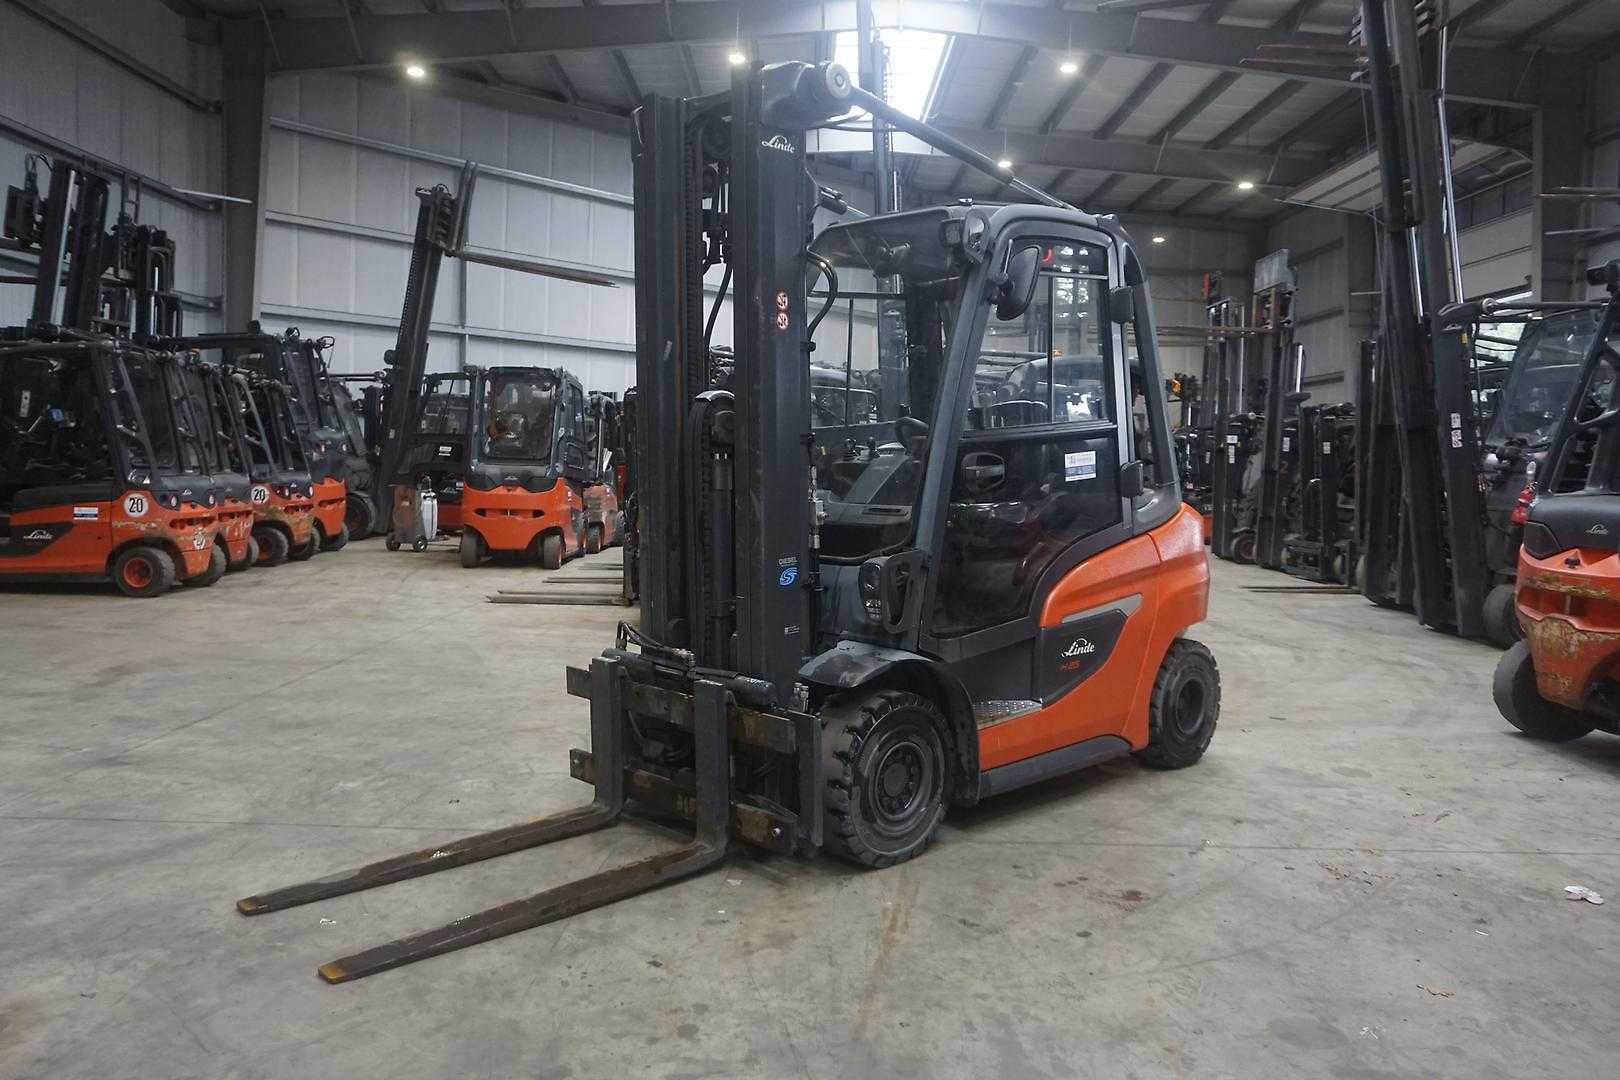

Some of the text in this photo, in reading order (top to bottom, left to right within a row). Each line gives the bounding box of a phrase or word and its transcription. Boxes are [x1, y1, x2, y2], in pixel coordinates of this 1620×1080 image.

[761, 135, 795, 153] Linde
[129, 498, 143, 512] 20
[23, 529, 53, 540] Linde
[1061, 637, 1095, 657] Linde
